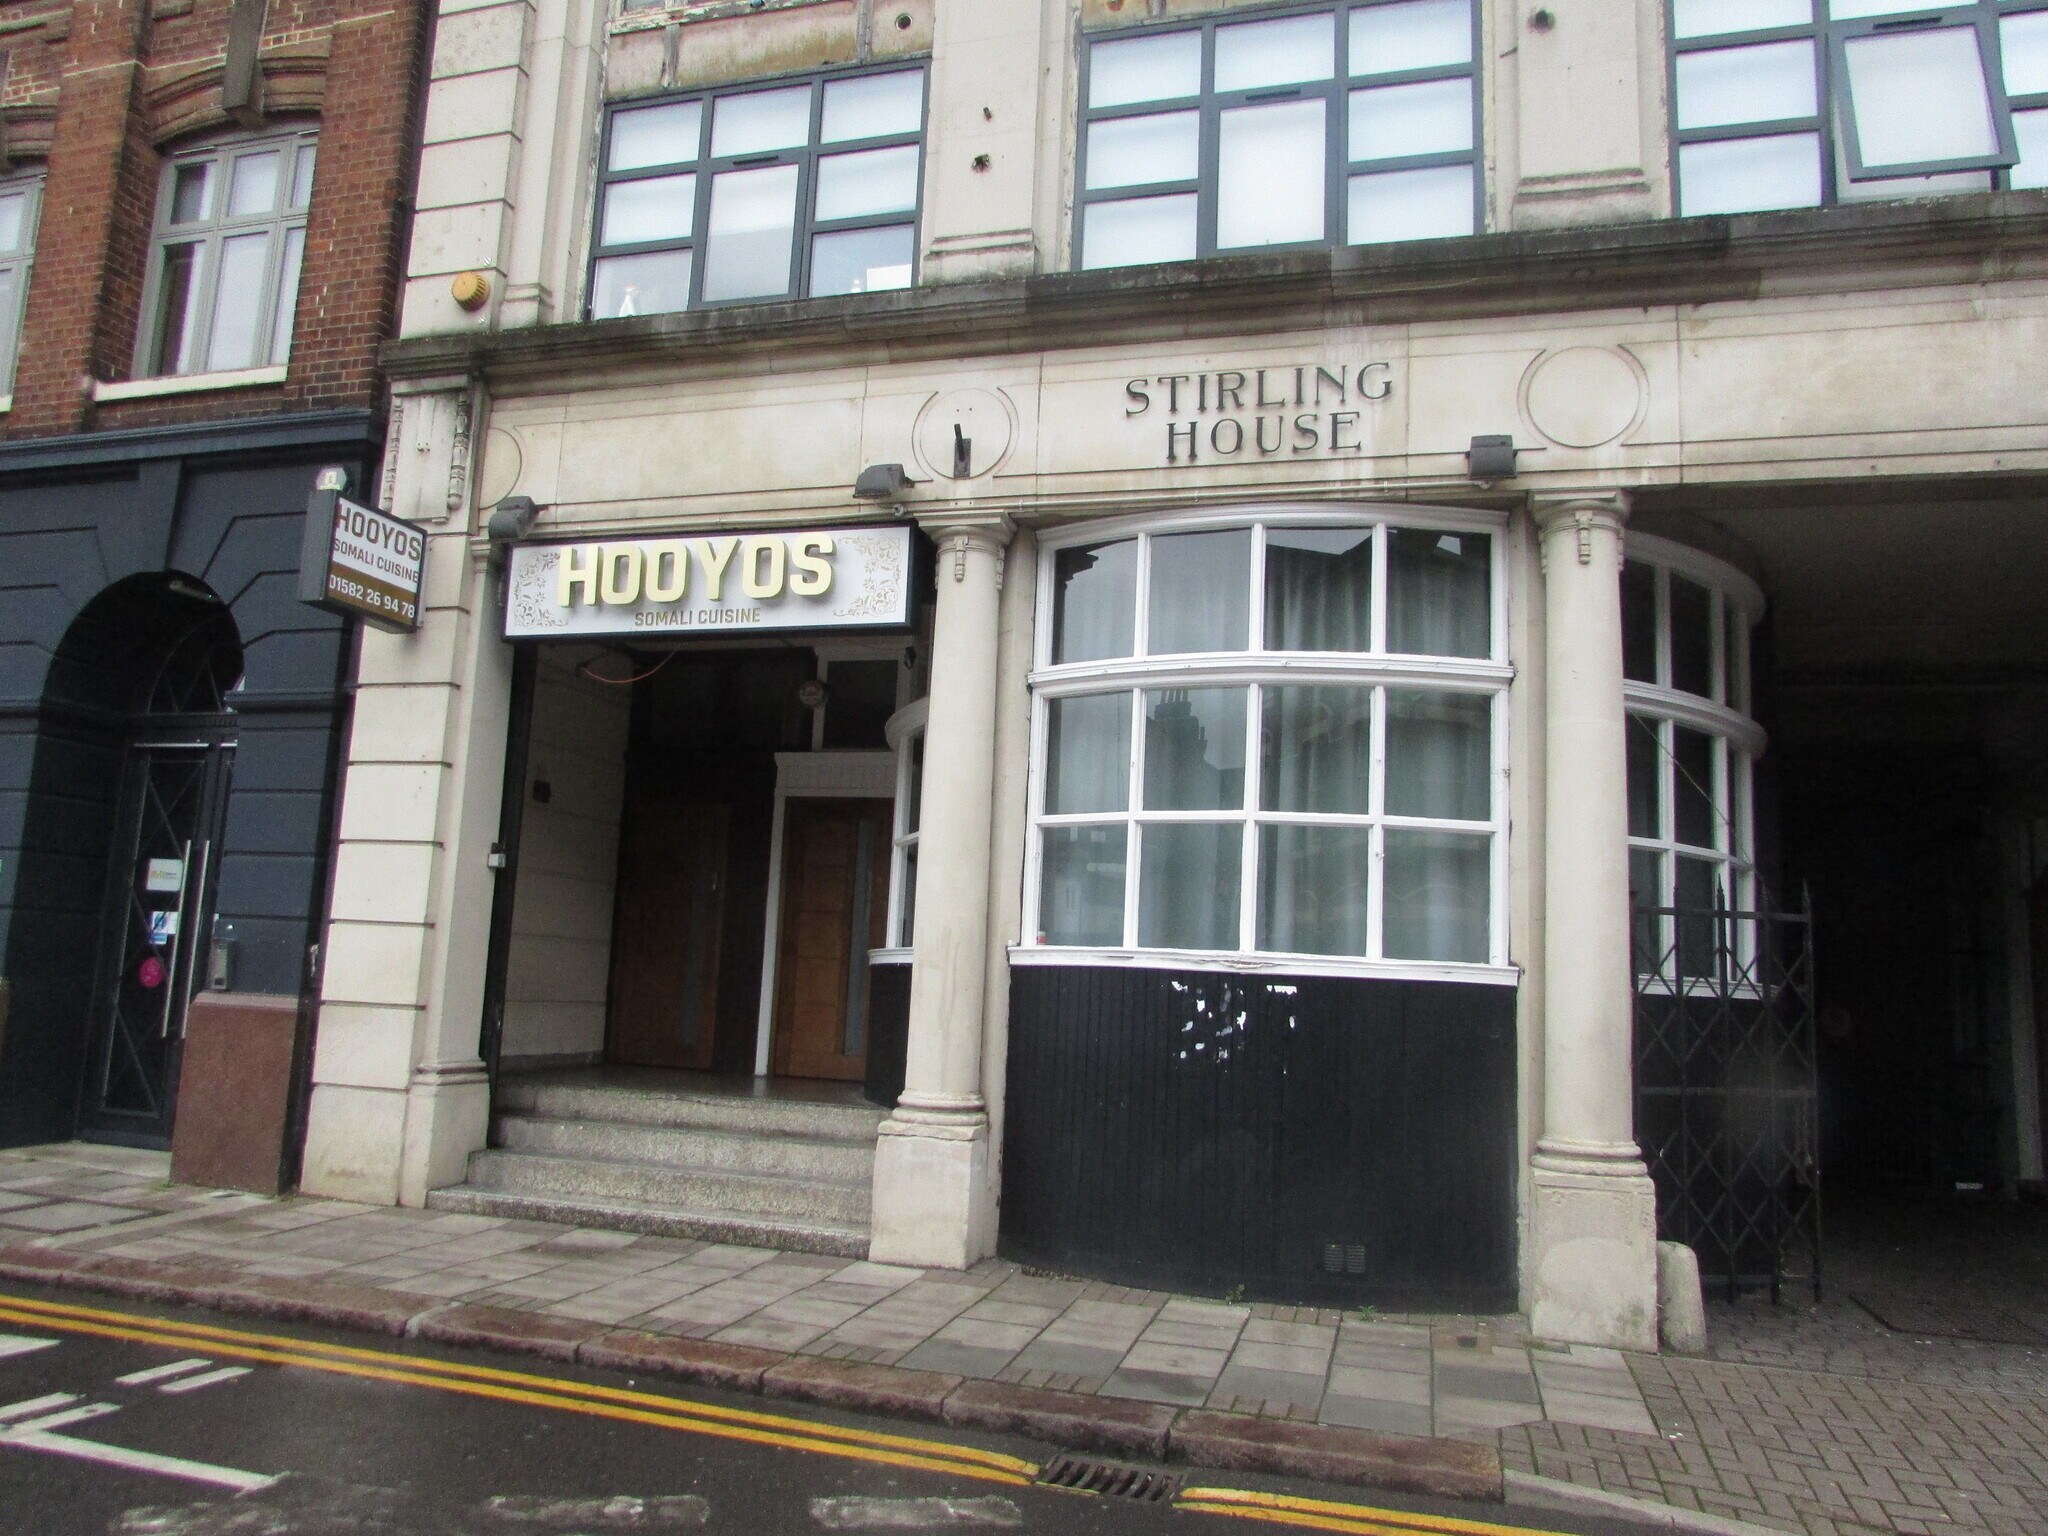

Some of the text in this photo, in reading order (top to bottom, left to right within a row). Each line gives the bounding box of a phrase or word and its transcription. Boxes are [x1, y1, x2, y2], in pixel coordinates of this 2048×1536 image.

[1125, 362, 1392, 418] STIRLING
[1166, 411, 1362, 462] HOUSE
[335, 504, 422, 562] HOOYOS
[334, 538, 419, 583] SOMALI CUISINE
[557, 532, 837, 607] HOOYOS
[329, 574, 415, 619] 01582 26 94 78
[634, 607, 761, 627] SOMALI CUISINE
